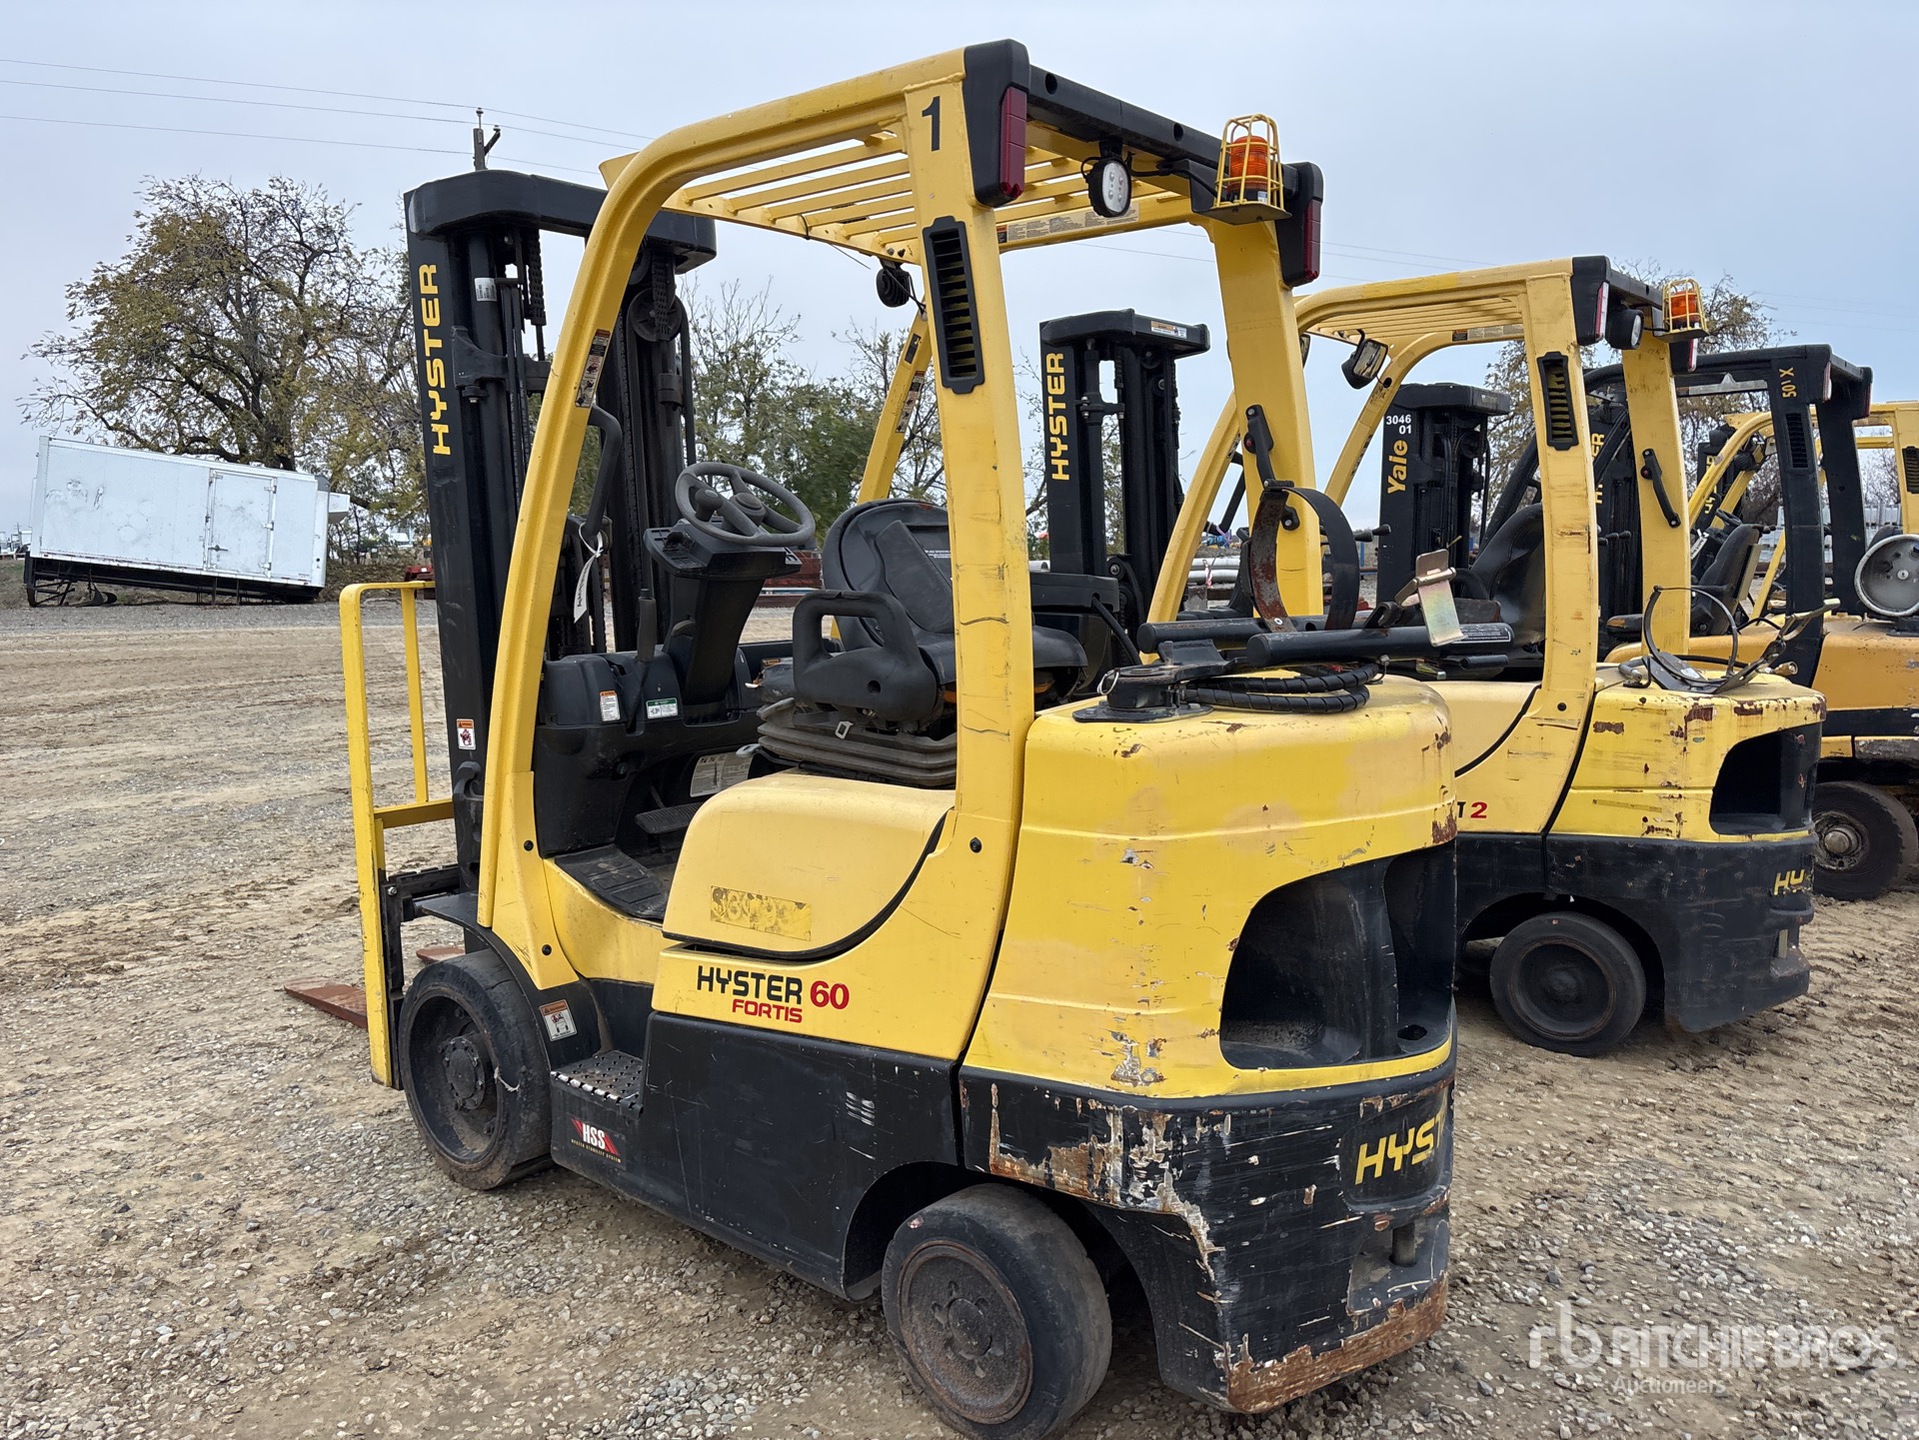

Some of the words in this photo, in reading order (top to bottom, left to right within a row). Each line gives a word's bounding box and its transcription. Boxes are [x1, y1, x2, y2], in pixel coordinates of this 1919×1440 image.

[921, 95, 941, 152] 1
[418, 263, 452, 455] HYSTER
[1045, 352, 1070, 481] HYSTER
[1386, 414, 1412, 425] 3046
[1398, 424, 1412, 435] 01
[1387, 439, 1409, 494] Yale
[696, 965, 803, 1005] HYSTER
[809, 980, 850, 1010] 60
[731, 998, 804, 1024] FORTIS
[582, 1123, 606, 1150] HSS
